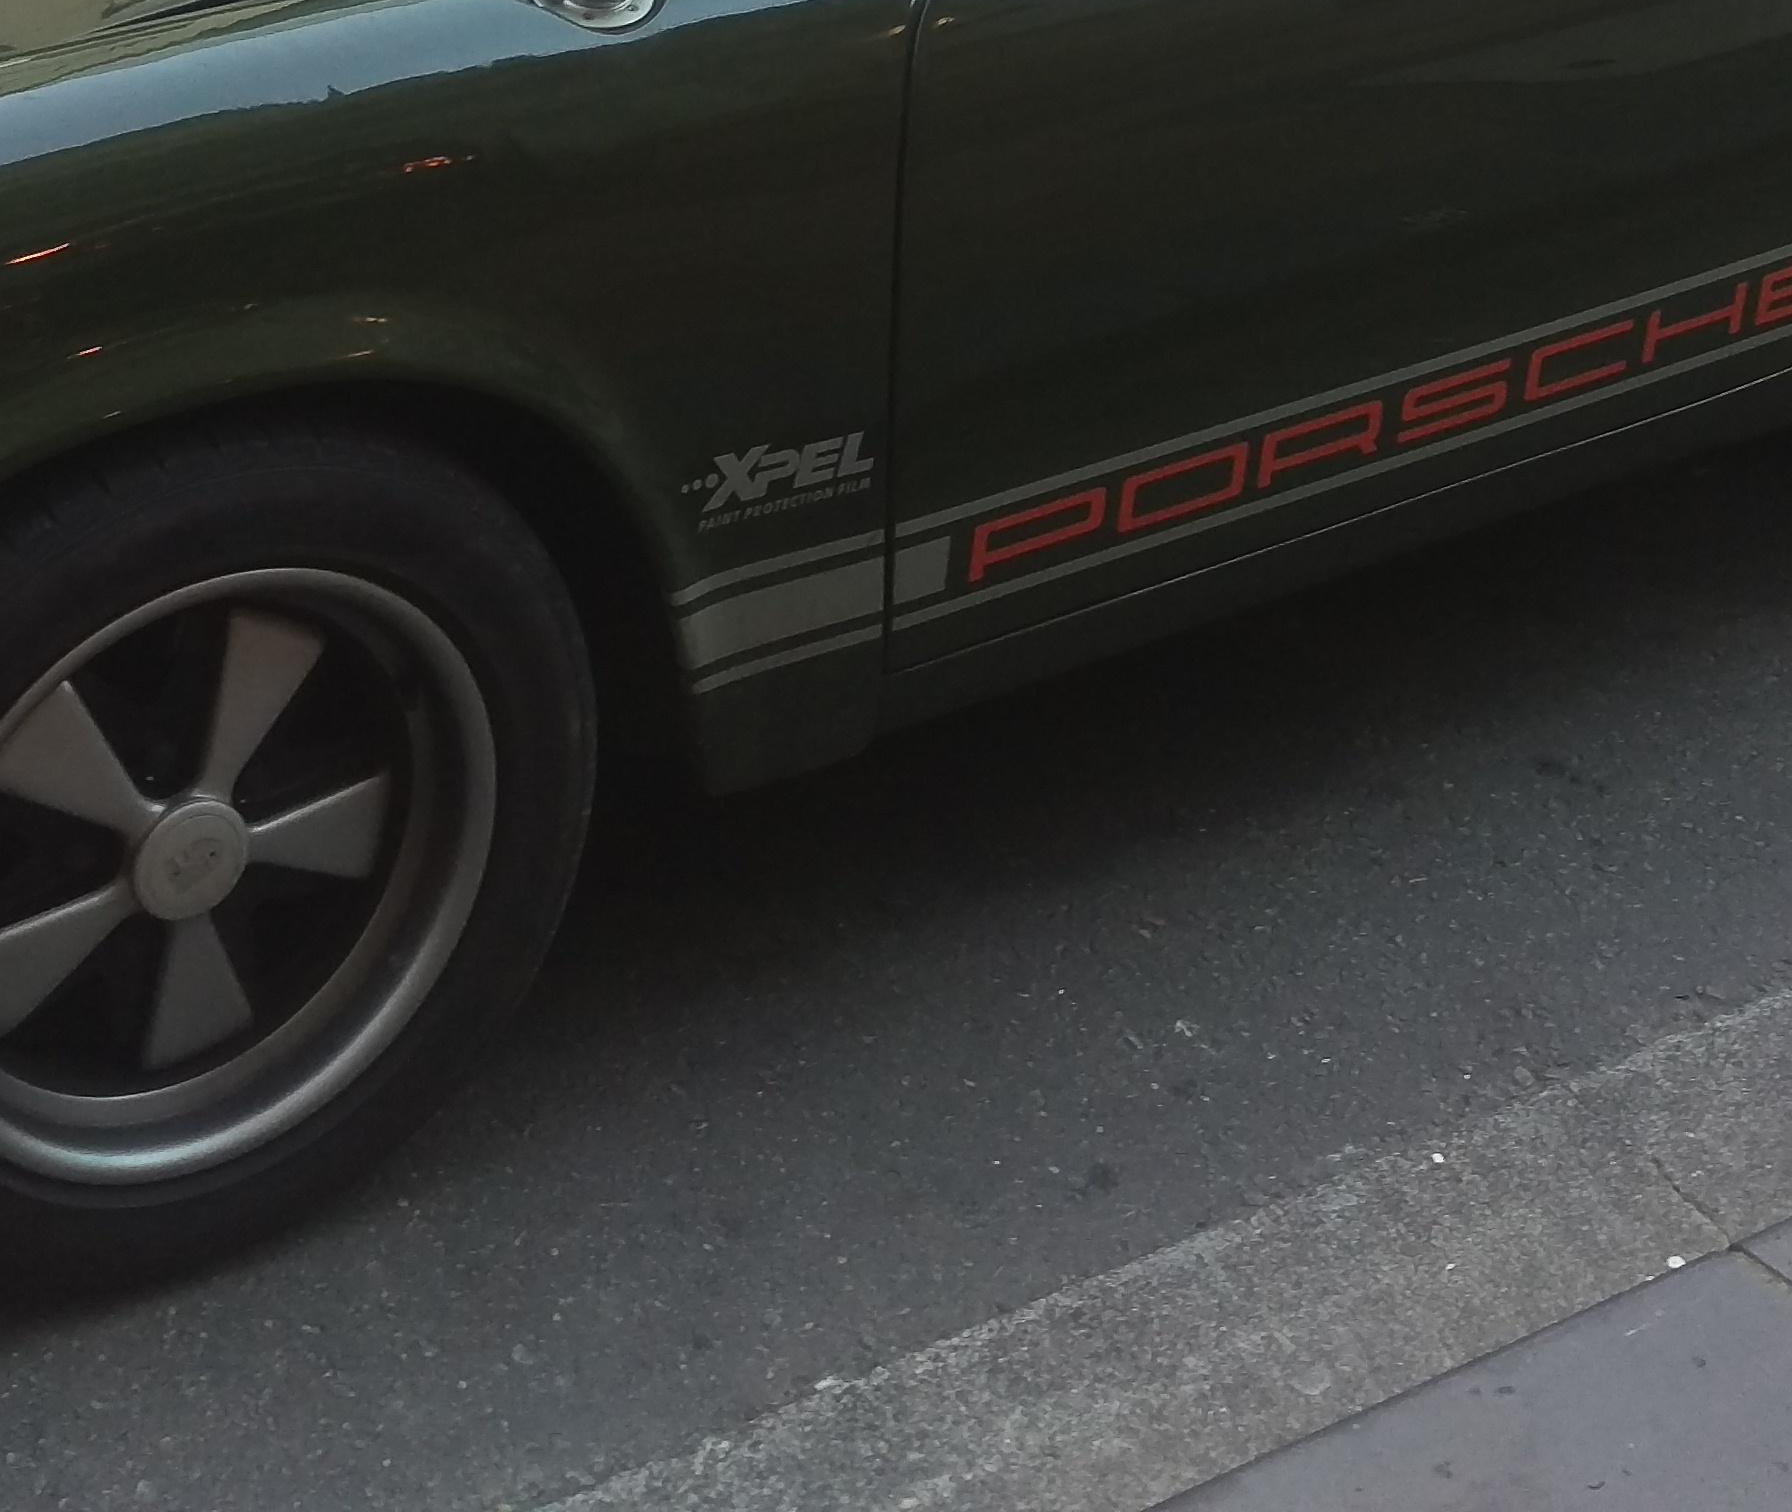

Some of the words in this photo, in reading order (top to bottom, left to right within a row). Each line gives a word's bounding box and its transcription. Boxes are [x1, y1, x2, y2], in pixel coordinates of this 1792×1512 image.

[698, 510, 741, 534] PAINT
[743, 487, 834, 520] PROTECTION
[837, 477, 872, 500] FILM
[701, 430, 875, 513] XPEL
